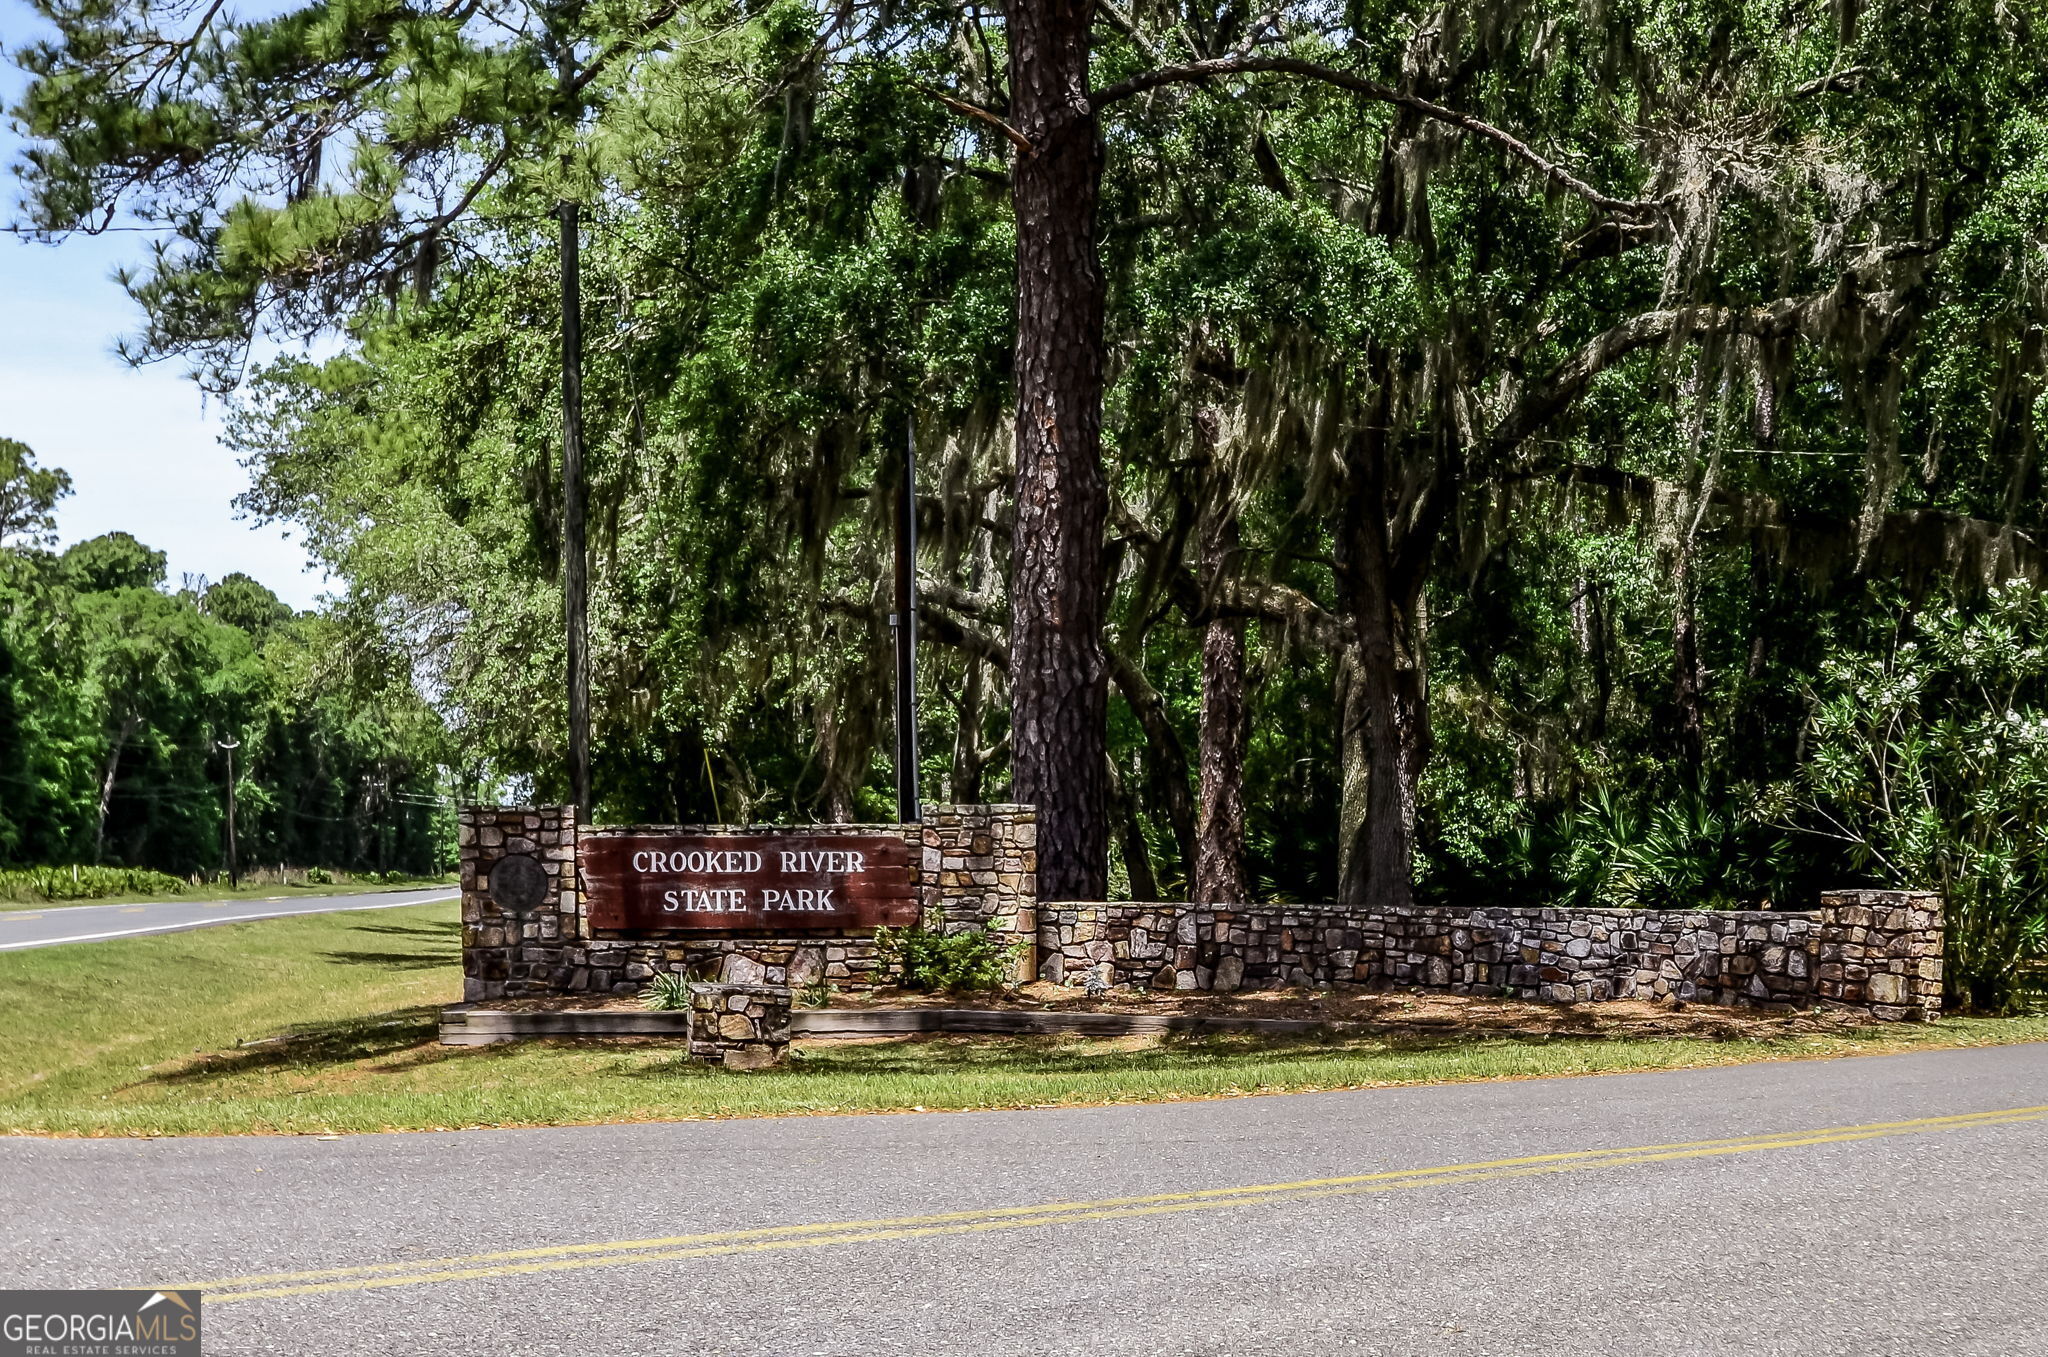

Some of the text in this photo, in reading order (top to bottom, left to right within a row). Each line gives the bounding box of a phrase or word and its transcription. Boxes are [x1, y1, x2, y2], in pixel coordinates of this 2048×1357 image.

[632, 850, 865, 874] CROOKED RIVER
[663, 888, 835, 912] STATE PARK
